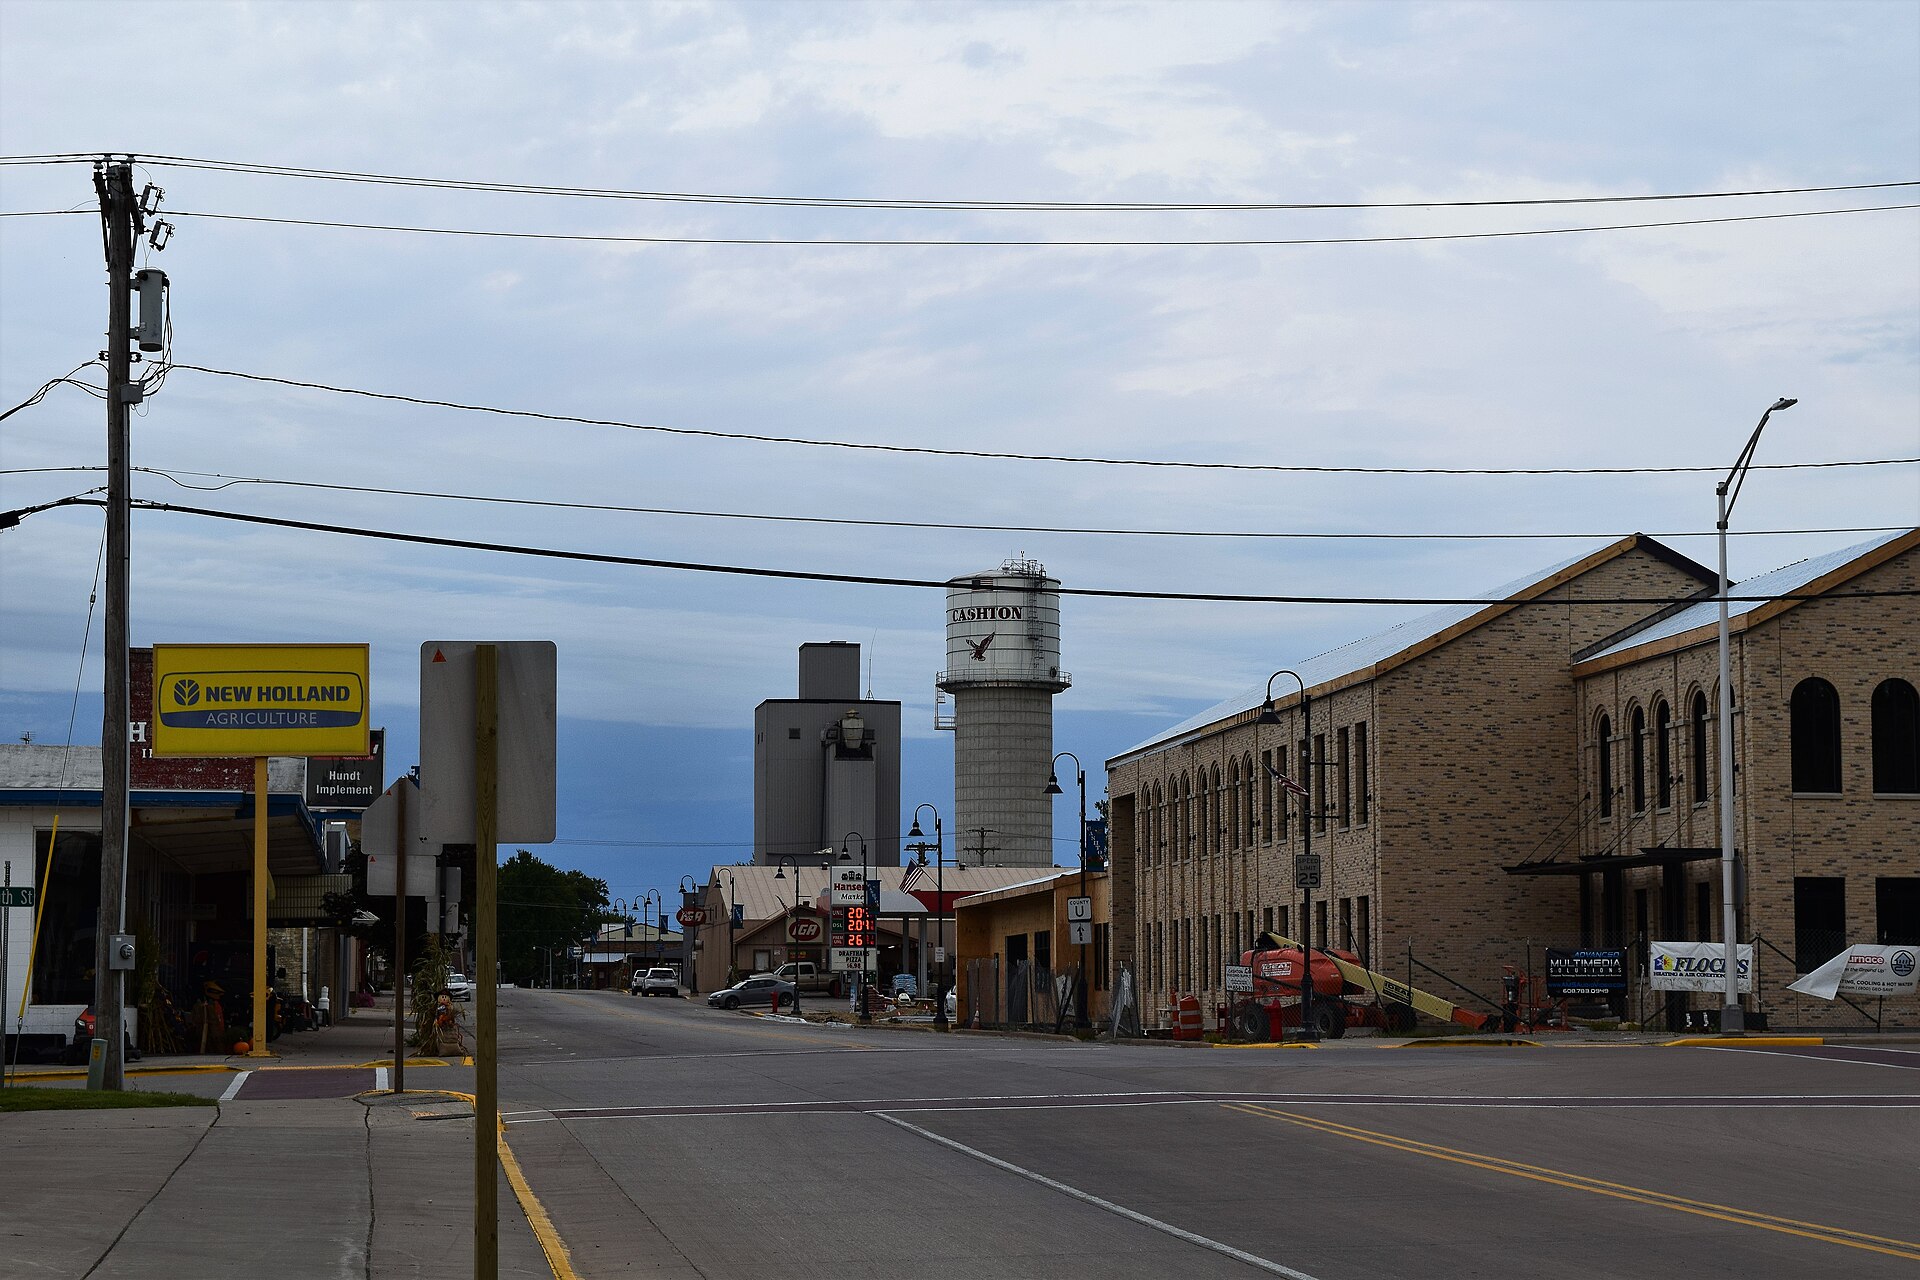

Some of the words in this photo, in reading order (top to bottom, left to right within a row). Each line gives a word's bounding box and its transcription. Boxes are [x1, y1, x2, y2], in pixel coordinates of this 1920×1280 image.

[952, 606, 1023, 622] CASHTON
[206, 686, 252, 702] NEW
[257, 686, 350, 702] HOLLAND
[206, 712, 318, 725] AGRICULTURE
[329, 770, 361, 781] Hundt
[316, 784, 373, 797] Implement
[1299, 873, 1318, 885] 25
[20, 890, 33, 905] St
[679, 910, 705, 922] IGA
[1075, 905, 1084, 918] U
[791, 924, 818, 936] IGA
[1550, 959, 1621, 967] MULTIMEDIA
